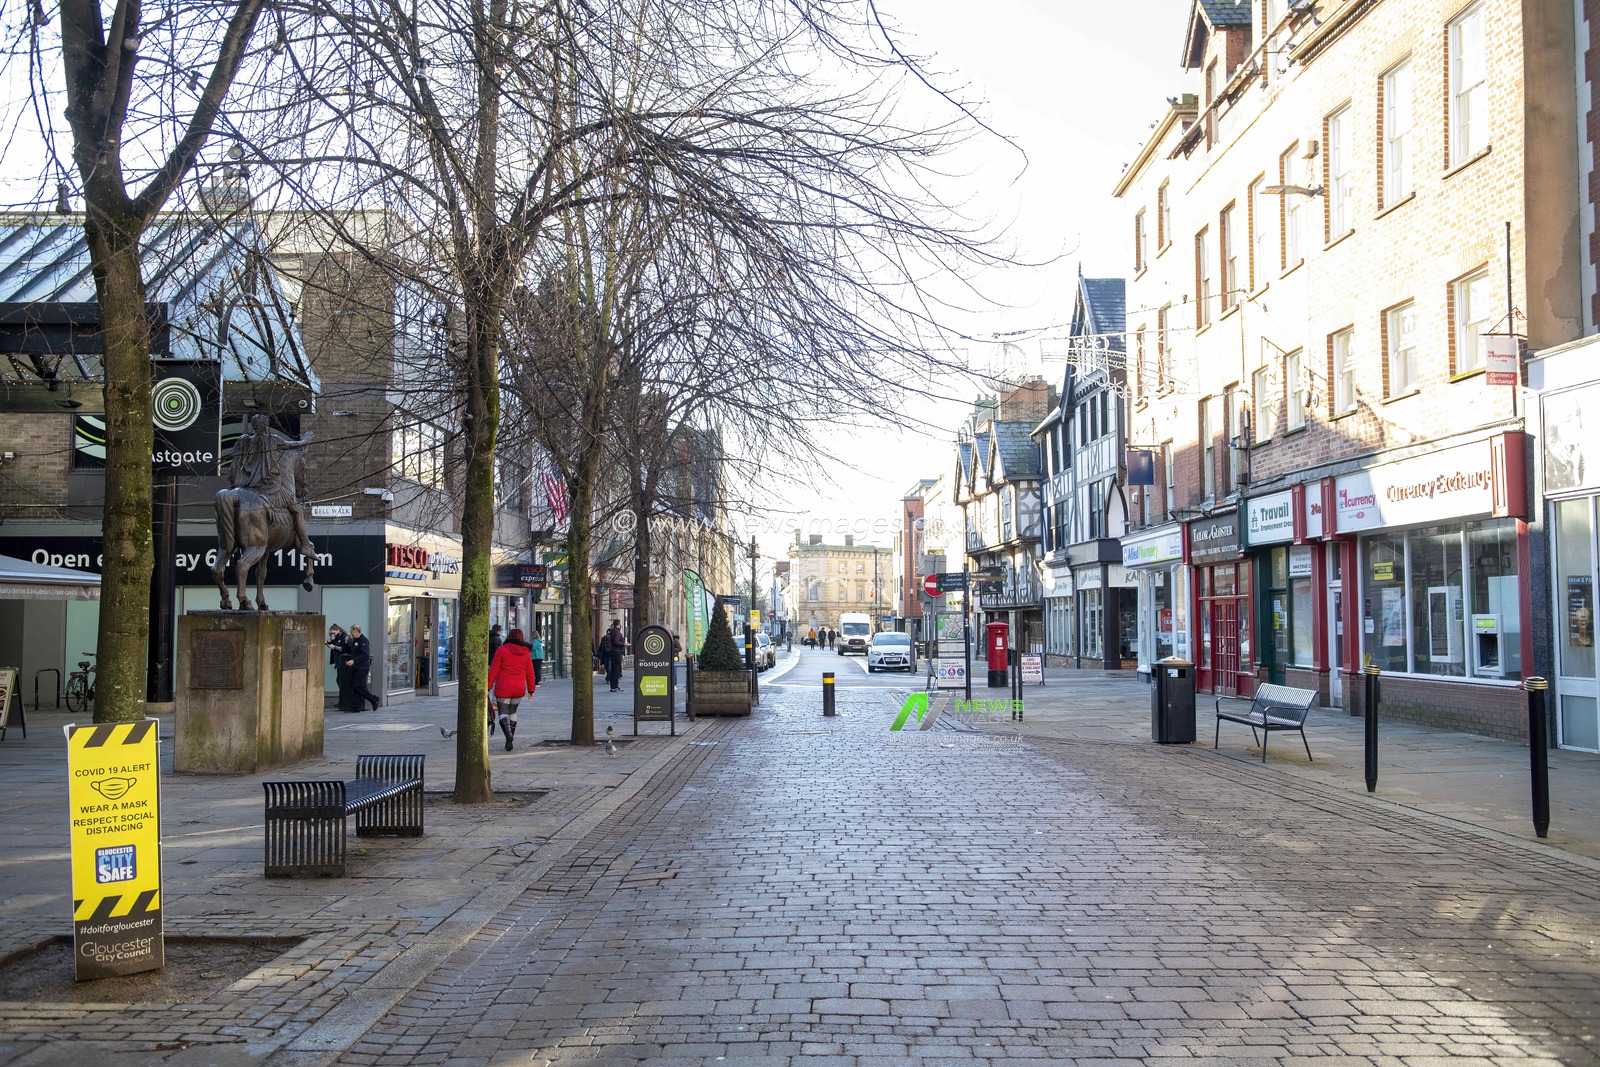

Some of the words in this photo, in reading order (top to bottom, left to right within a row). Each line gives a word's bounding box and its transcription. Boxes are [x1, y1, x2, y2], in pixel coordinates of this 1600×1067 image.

[152, 450, 213, 467] stgate
[1347, 494, 1376, 507] currency
[1260, 502, 1289, 521] Travail
[1260, 522, 1283, 531] Employment
[388, 543, 429, 570] TESCO
[75, 768, 105, 777] COVID
[108, 766, 118, 774] 19
[120, 763, 151, 773] ALERT
[80, 804, 109, 814] WEAR
[111, 803, 119, 811] A
[121, 800, 148, 810] MASK
[73, 816, 118, 827] RESPECT
[120, 812, 154, 822] SOCIAL
[86, 822, 143, 835] DISTANCING
[98, 847, 133, 856] GLOUCESTER
[98, 853, 133, 870] CITY
[98, 865, 133, 882] SAFE
[80, 918, 155, 935] #doitforgloucester
[80, 936, 155, 957] Gloucester
[95, 954, 116, 962] City
[116, 947, 151, 959] Council
